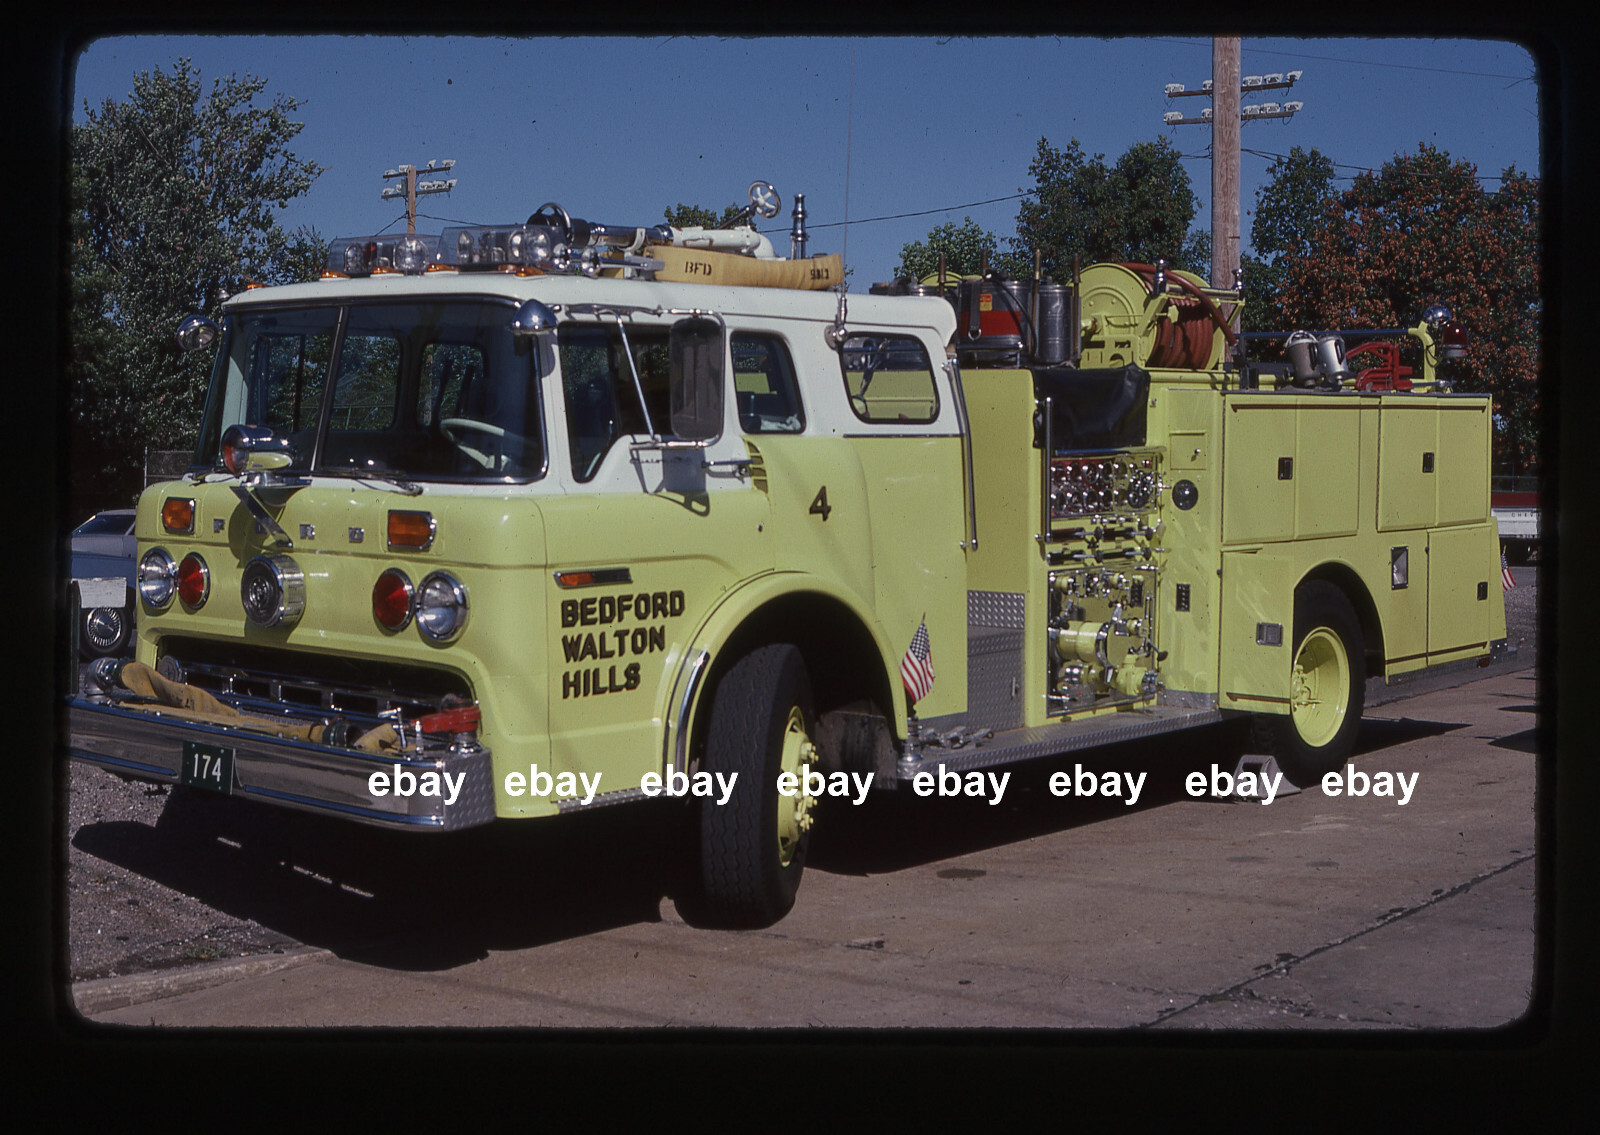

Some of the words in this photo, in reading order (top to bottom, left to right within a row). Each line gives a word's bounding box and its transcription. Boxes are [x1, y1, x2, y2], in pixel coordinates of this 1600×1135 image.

[685, 261, 712, 276] BFD
[809, 485, 832, 522] 4
[561, 590, 685, 628] BEDFORD
[561, 625, 666, 663] WALTON
[562, 662, 641, 699] HILLS
[193, 752, 222, 783] 174
